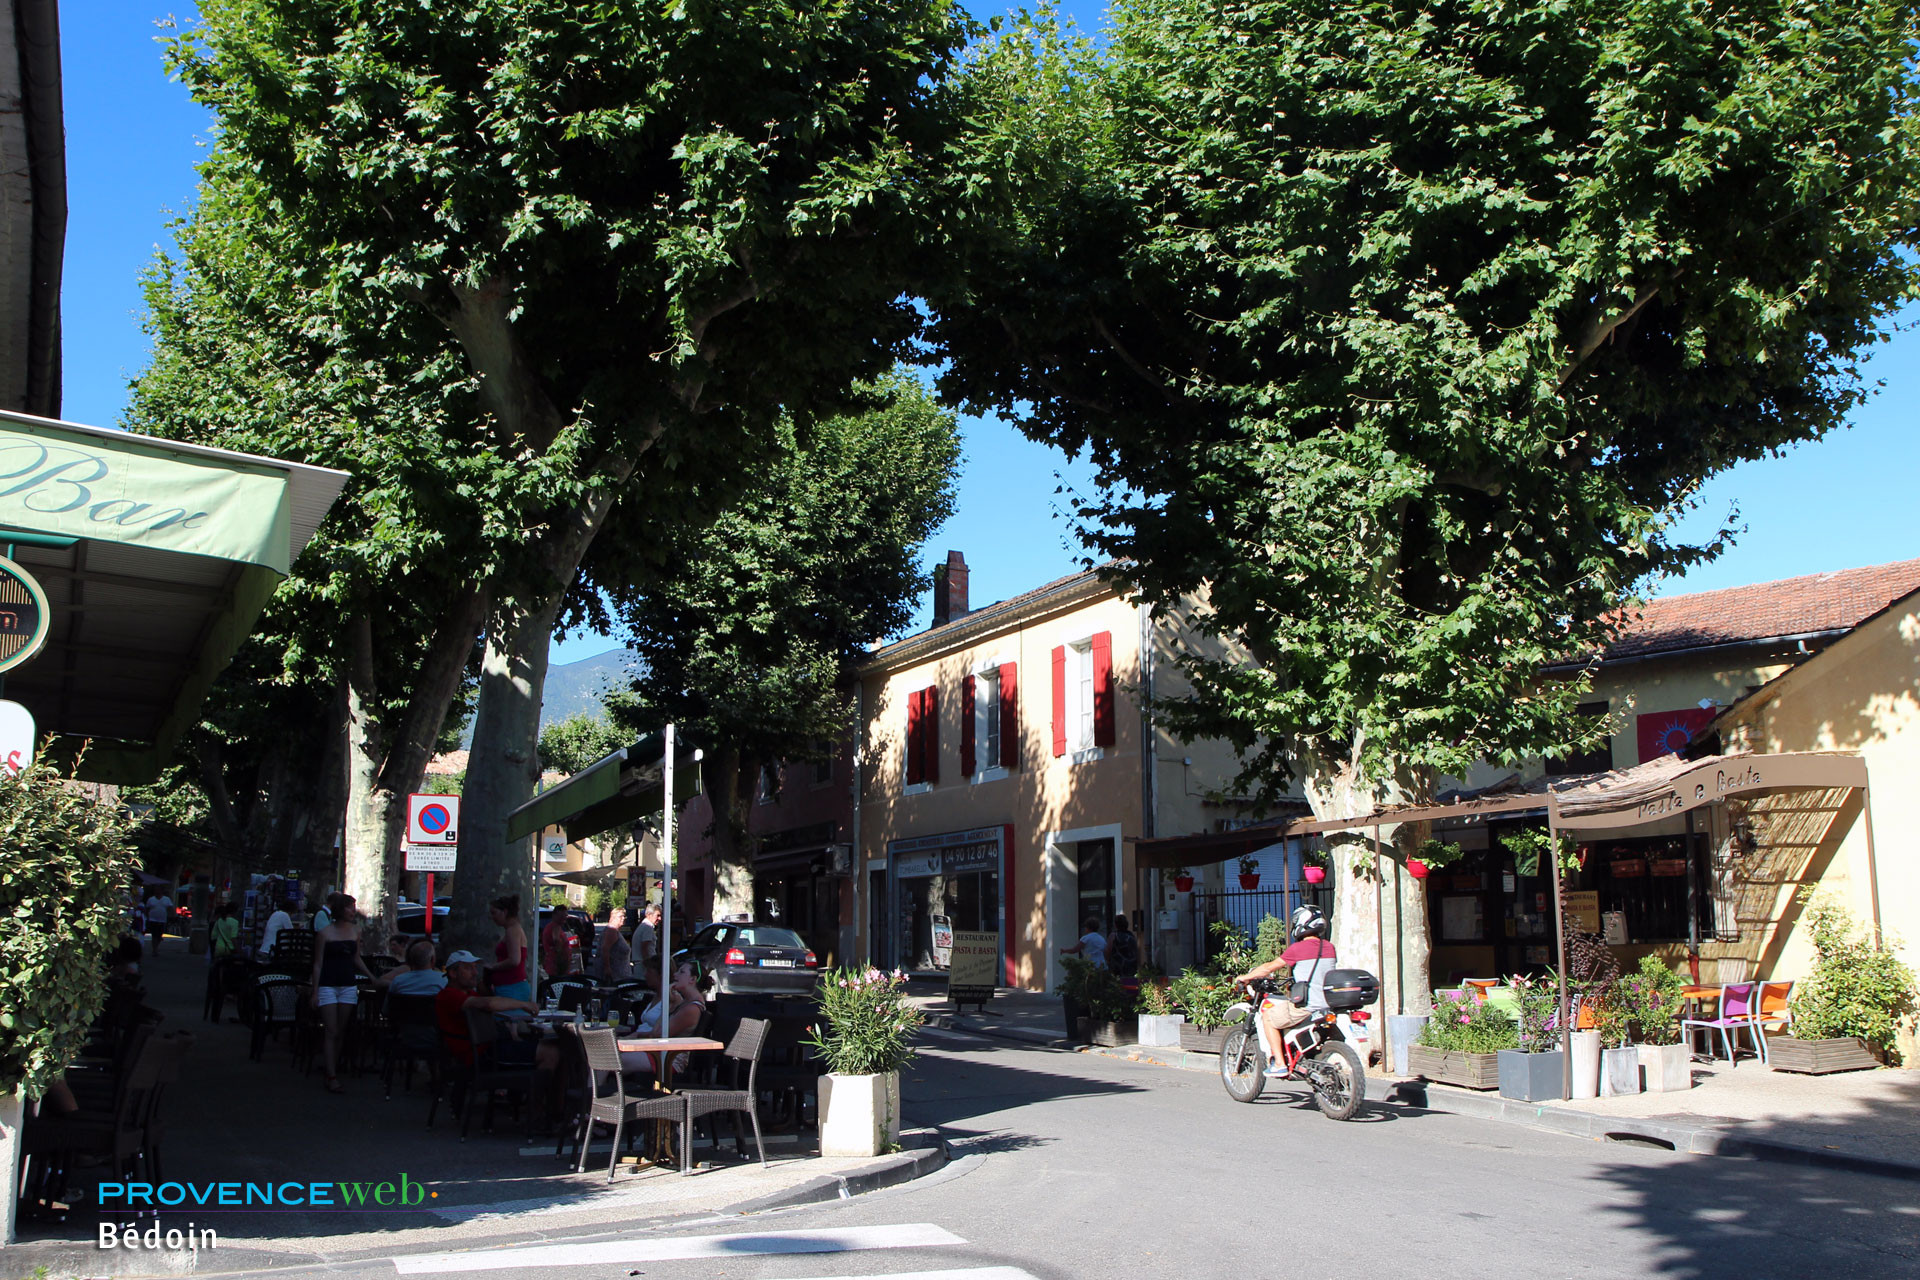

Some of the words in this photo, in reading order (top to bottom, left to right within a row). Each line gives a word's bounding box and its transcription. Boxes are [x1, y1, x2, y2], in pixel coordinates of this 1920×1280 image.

[0, 437, 208, 530] Bar
[1637, 790, 1683, 818] Pasta
[1717, 765, 1761, 792] Basta
[945, 850, 954, 863] 04
[956, 849, 965, 862] 90
[967, 848, 975, 860] 12
[977, 846, 986, 859] 87
[988, 844, 998, 858] 46
[956, 934, 996, 942] RESTAURANT
[953, 946, 971, 955] PASTA
[978, 947, 997, 955] BASTA
